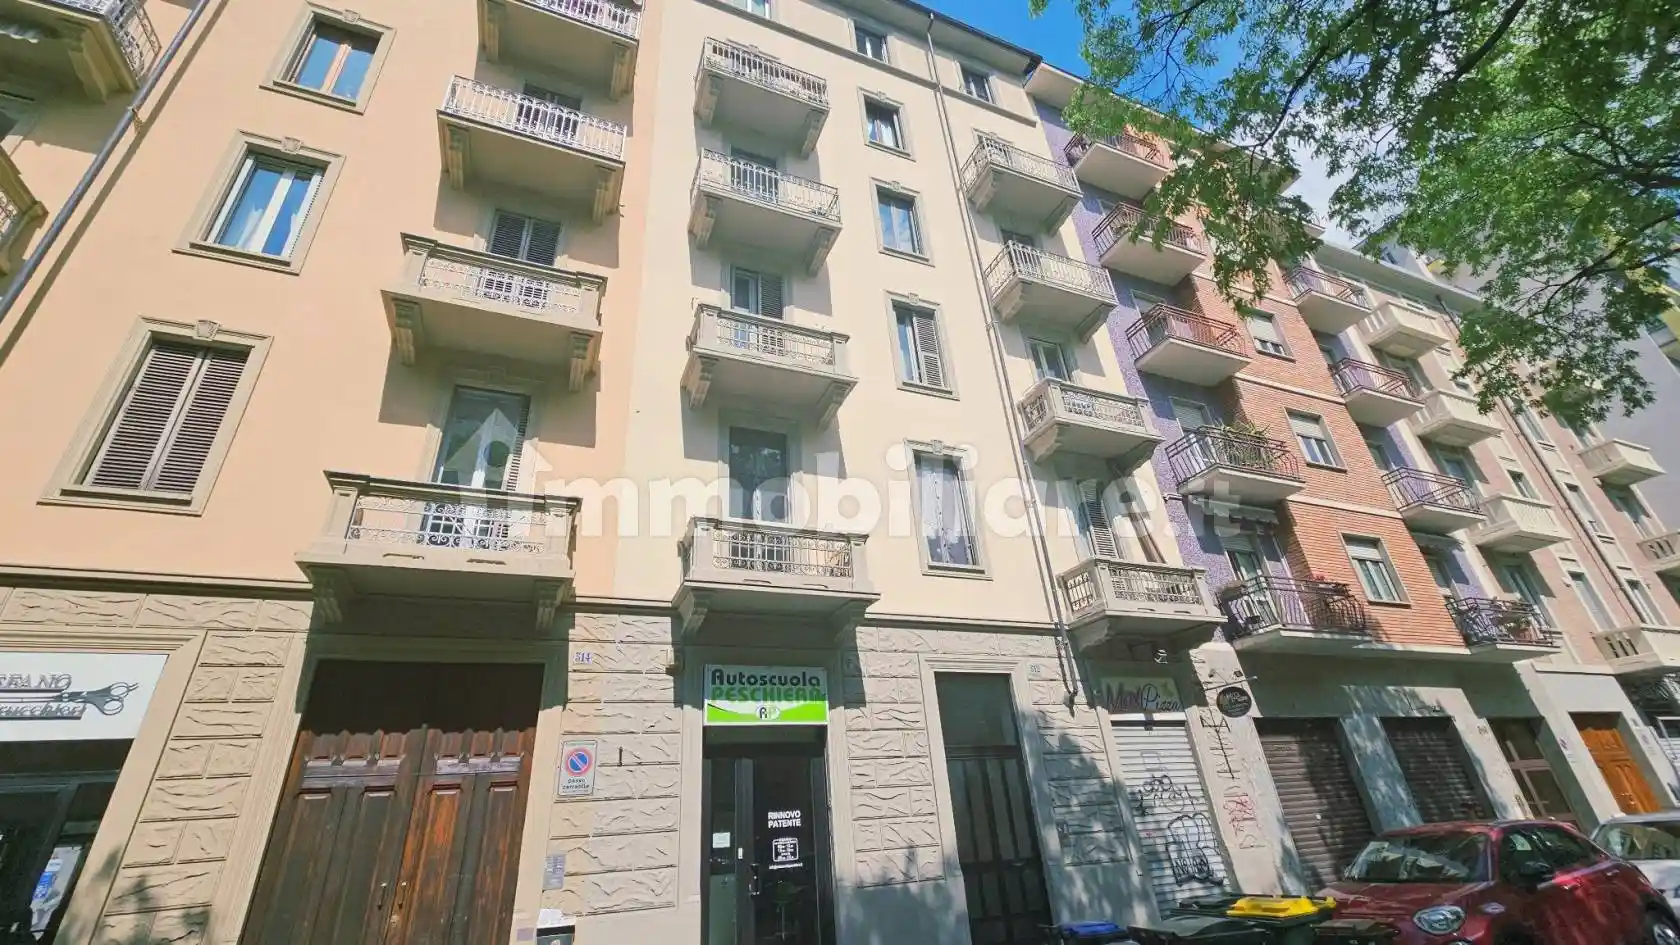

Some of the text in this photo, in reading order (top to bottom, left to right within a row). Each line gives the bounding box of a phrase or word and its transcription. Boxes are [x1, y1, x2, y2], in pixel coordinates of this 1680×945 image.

[711, 668, 820, 687] Autoscuola
[711, 686, 823, 702] PESCHIERA
[768, 810, 802, 820] RINNOVO
[768, 819, 802, 829] PATENTE
